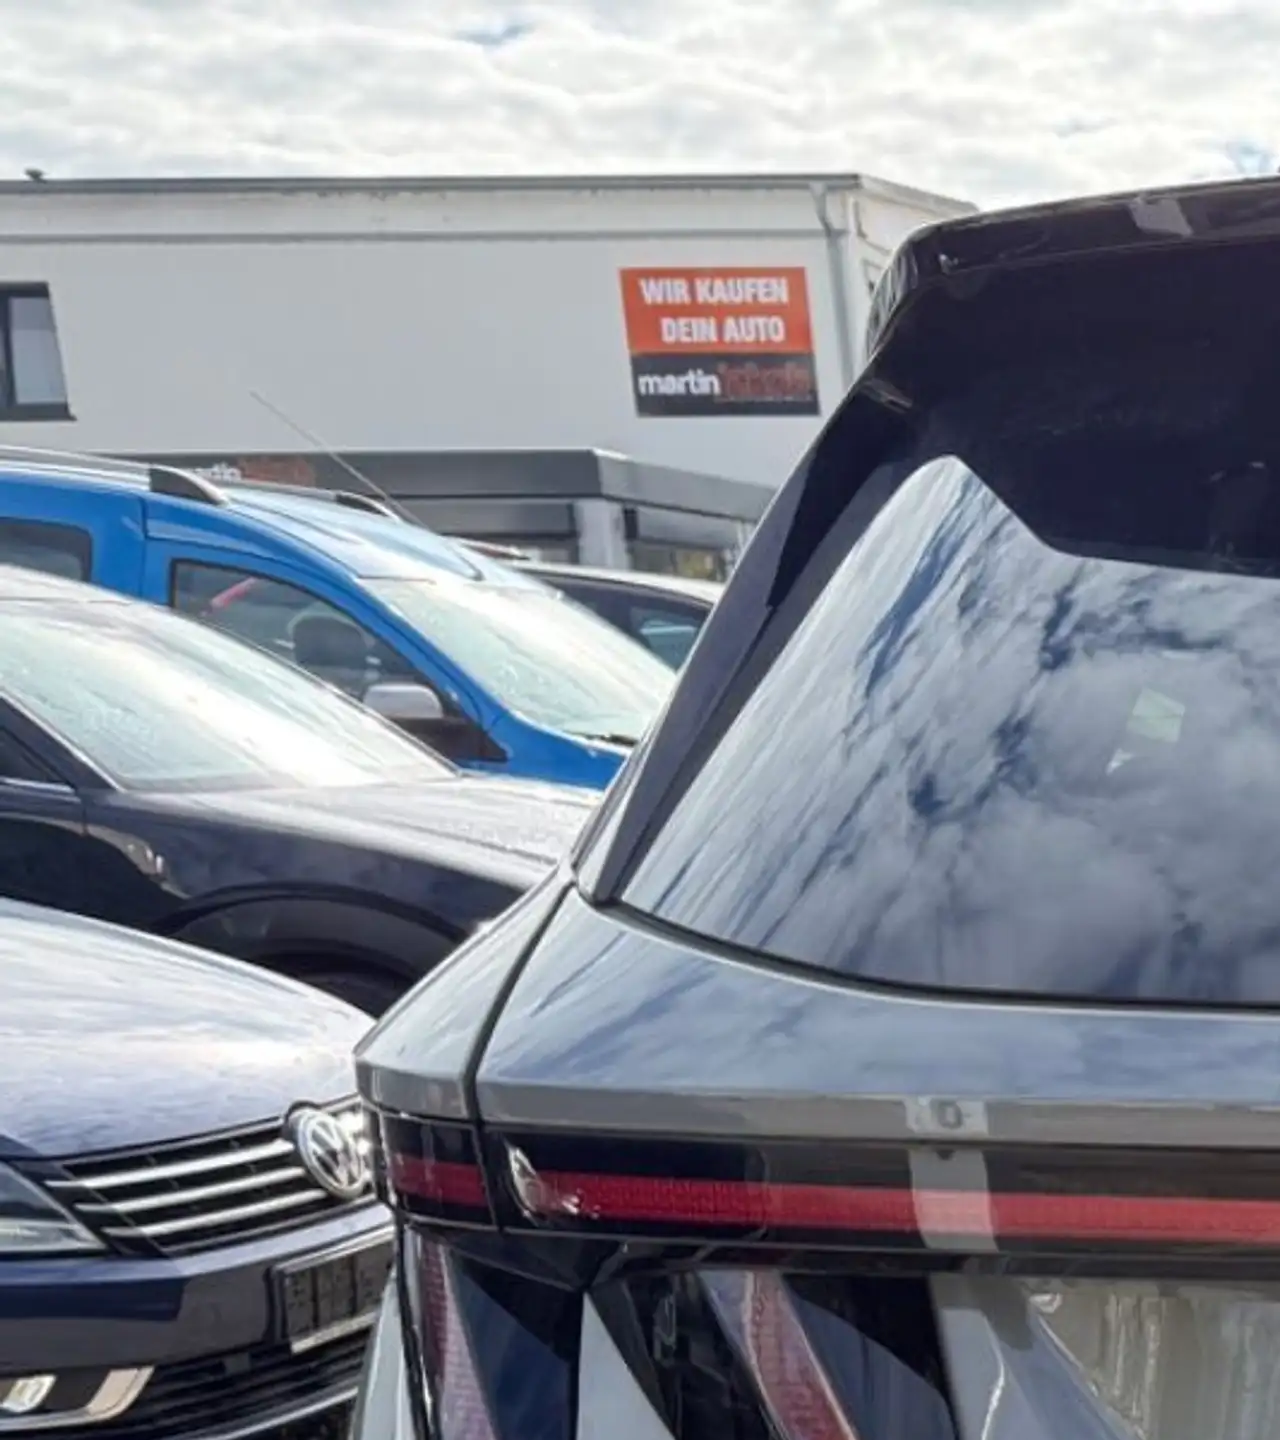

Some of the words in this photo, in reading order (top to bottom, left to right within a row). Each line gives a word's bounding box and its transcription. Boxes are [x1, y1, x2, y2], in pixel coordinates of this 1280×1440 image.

[638, 277, 691, 305] WIR
[693, 277, 789, 305] KAUFEN
[660, 316, 717, 343] DEIN
[722, 316, 786, 343] AUTO
[638, 367, 720, 396] martin
